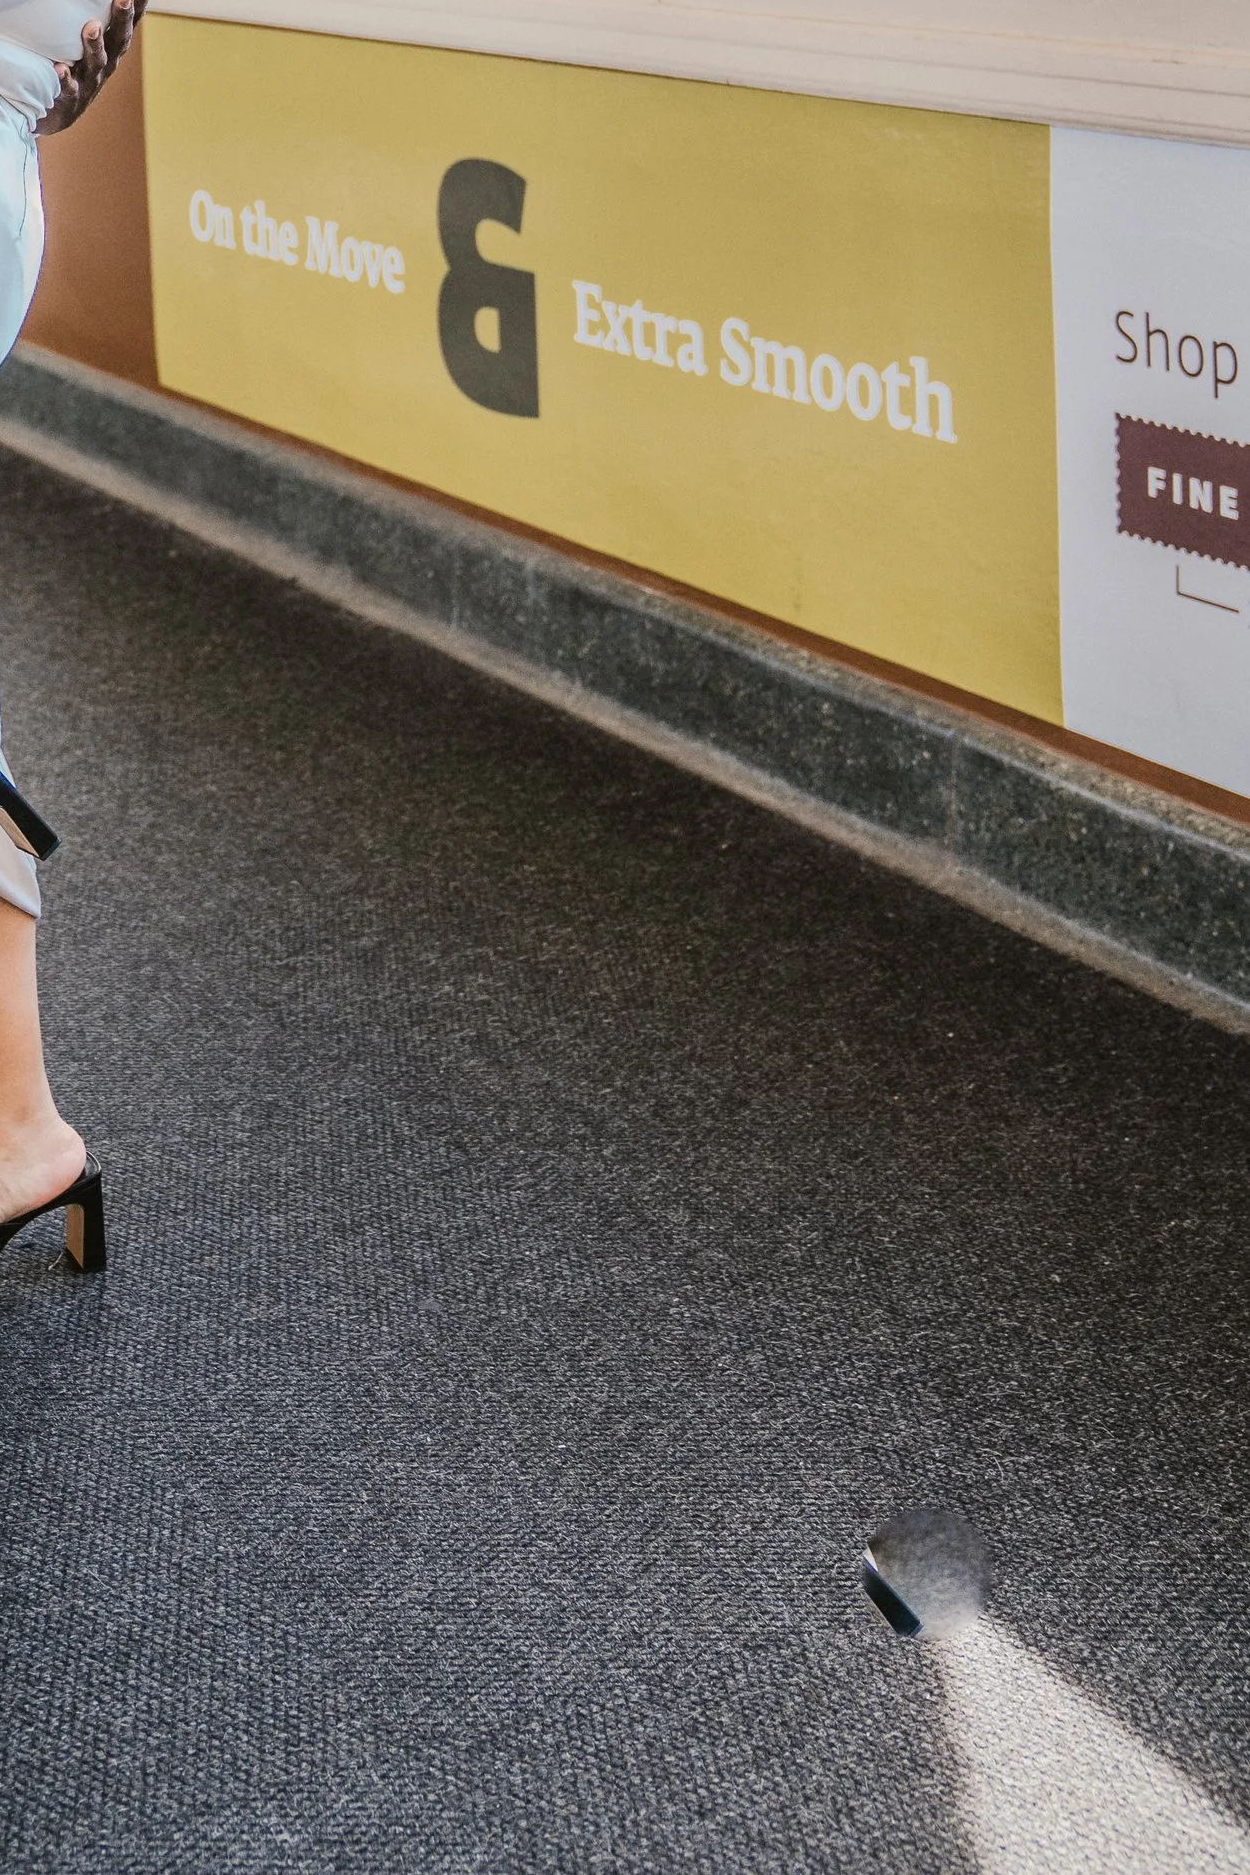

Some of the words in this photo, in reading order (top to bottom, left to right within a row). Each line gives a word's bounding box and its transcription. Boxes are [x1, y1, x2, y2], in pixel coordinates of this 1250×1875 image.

[190, 189, 237, 250] On
[240, 200, 299, 266] the
[304, 215, 406, 294] Move
[572, 279, 708, 377] Extra
[719, 316, 958, 444] Smooth
[1114, 309, 1239, 400] Shop
[1147, 466, 1239, 521] FINE
